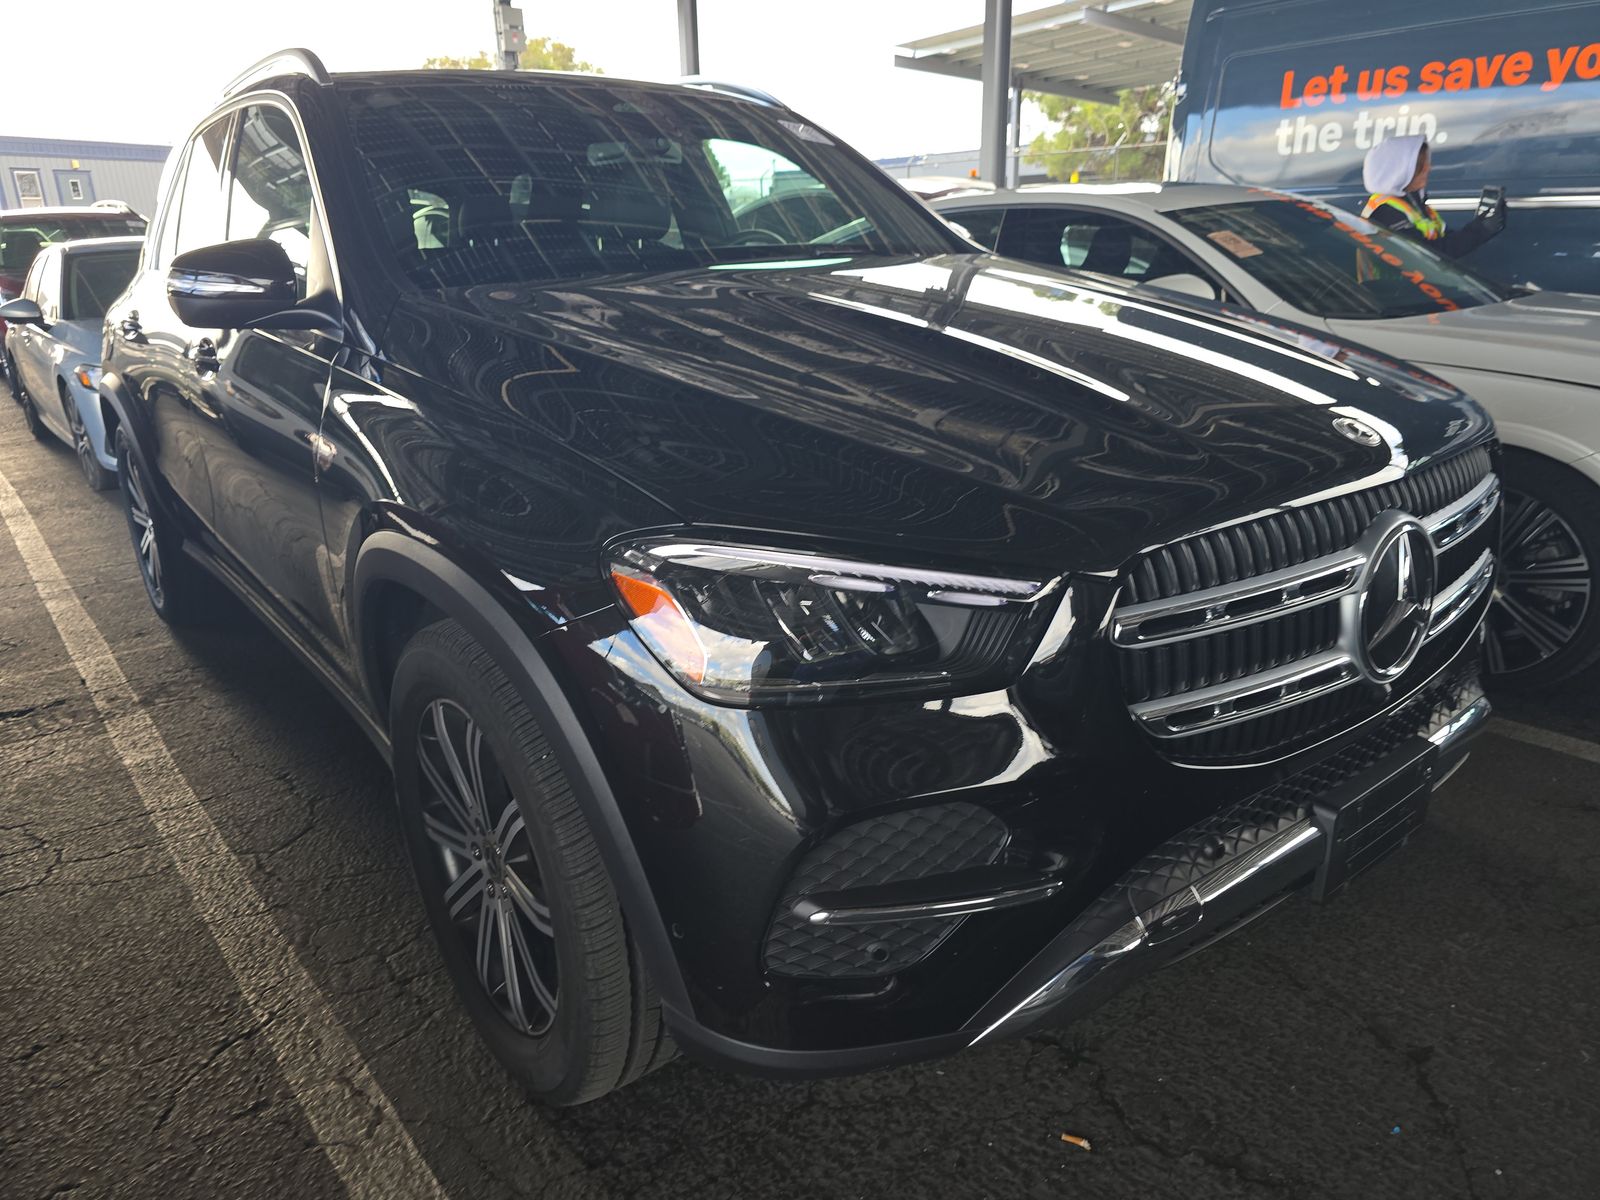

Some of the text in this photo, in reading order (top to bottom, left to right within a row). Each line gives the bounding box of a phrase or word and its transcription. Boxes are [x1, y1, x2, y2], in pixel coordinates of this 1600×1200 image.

[1280, 65, 1348, 109] Let
[1356, 65, 1411, 101] us
[1417, 51, 1534, 94] save
[1275, 116, 1343, 156] the
